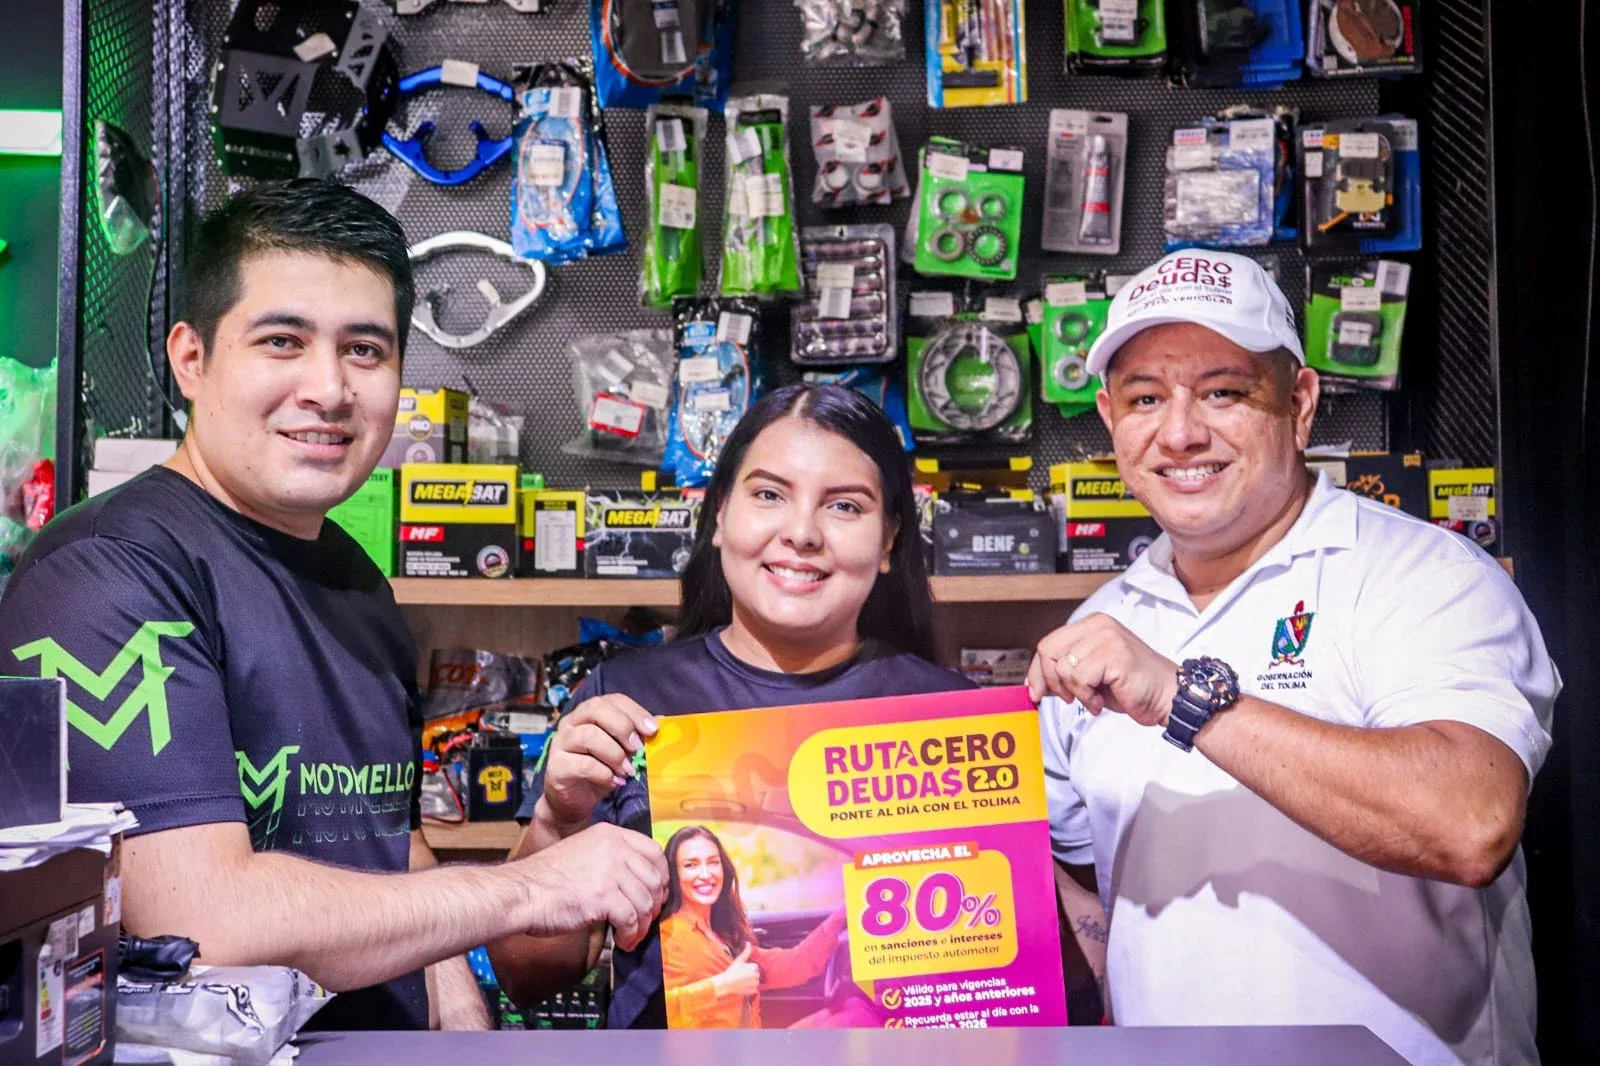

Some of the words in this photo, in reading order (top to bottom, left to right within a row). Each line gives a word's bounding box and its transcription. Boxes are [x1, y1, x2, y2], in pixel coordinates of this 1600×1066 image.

[1157, 257, 1232, 275] CERO
[414, 482, 505, 502] MEGABAT
[607, 509, 689, 526] MEGABAT
[409, 527, 439, 540] MF
[1075, 523, 1101, 536] MF
[972, 535, 1015, 552] BENF
[1257, 670, 1312, 681] GOBERNACIÓN
[1261, 682, 1274, 690] DEL
[1278, 681, 1306, 690] TOLIMA
[824, 740, 919, 775] RUTA
[920, 731, 1016, 766] CERO
[972, 766, 1015, 790] 2.0
[830, 809, 873, 822] PONTE
[877, 806, 893, 817] AL
[897, 802, 920, 815] DÍA
[923, 802, 950, 813] CON
[954, 800, 968, 810] EL
[972, 795, 1020, 809] TOLIMA
[862, 847, 953, 867] APROVECHA
[954, 845, 972, 858] EL
[860, 870, 1001, 938] 80%
[864, 944, 878, 953] en
[880, 937, 938, 951] sanciones
[950, 932, 1003, 944] intereses
[868, 955, 886, 966] del
[888, 951, 940, 965] impuesto
[942, 945, 1000, 958] automotor
[903, 984, 935, 996] Válido
[936, 982, 958, 994] para
[959, 977, 1006, 992] vigencias
[903, 995, 933, 1008] 2025
[934, 995, 943, 1007] y
[944, 991, 973, 1003] años
[975, 985, 1036, 1001] anteriores
[904, 1012, 953, 1026] Recuerda
[954, 1009, 979, 1021] estar
[980, 1007, 990, 1017] al
[992, 1006, 1008, 1017] día
[1009, 1005, 1027, 1015] con
[1029, 1003, 1040, 1013] la
